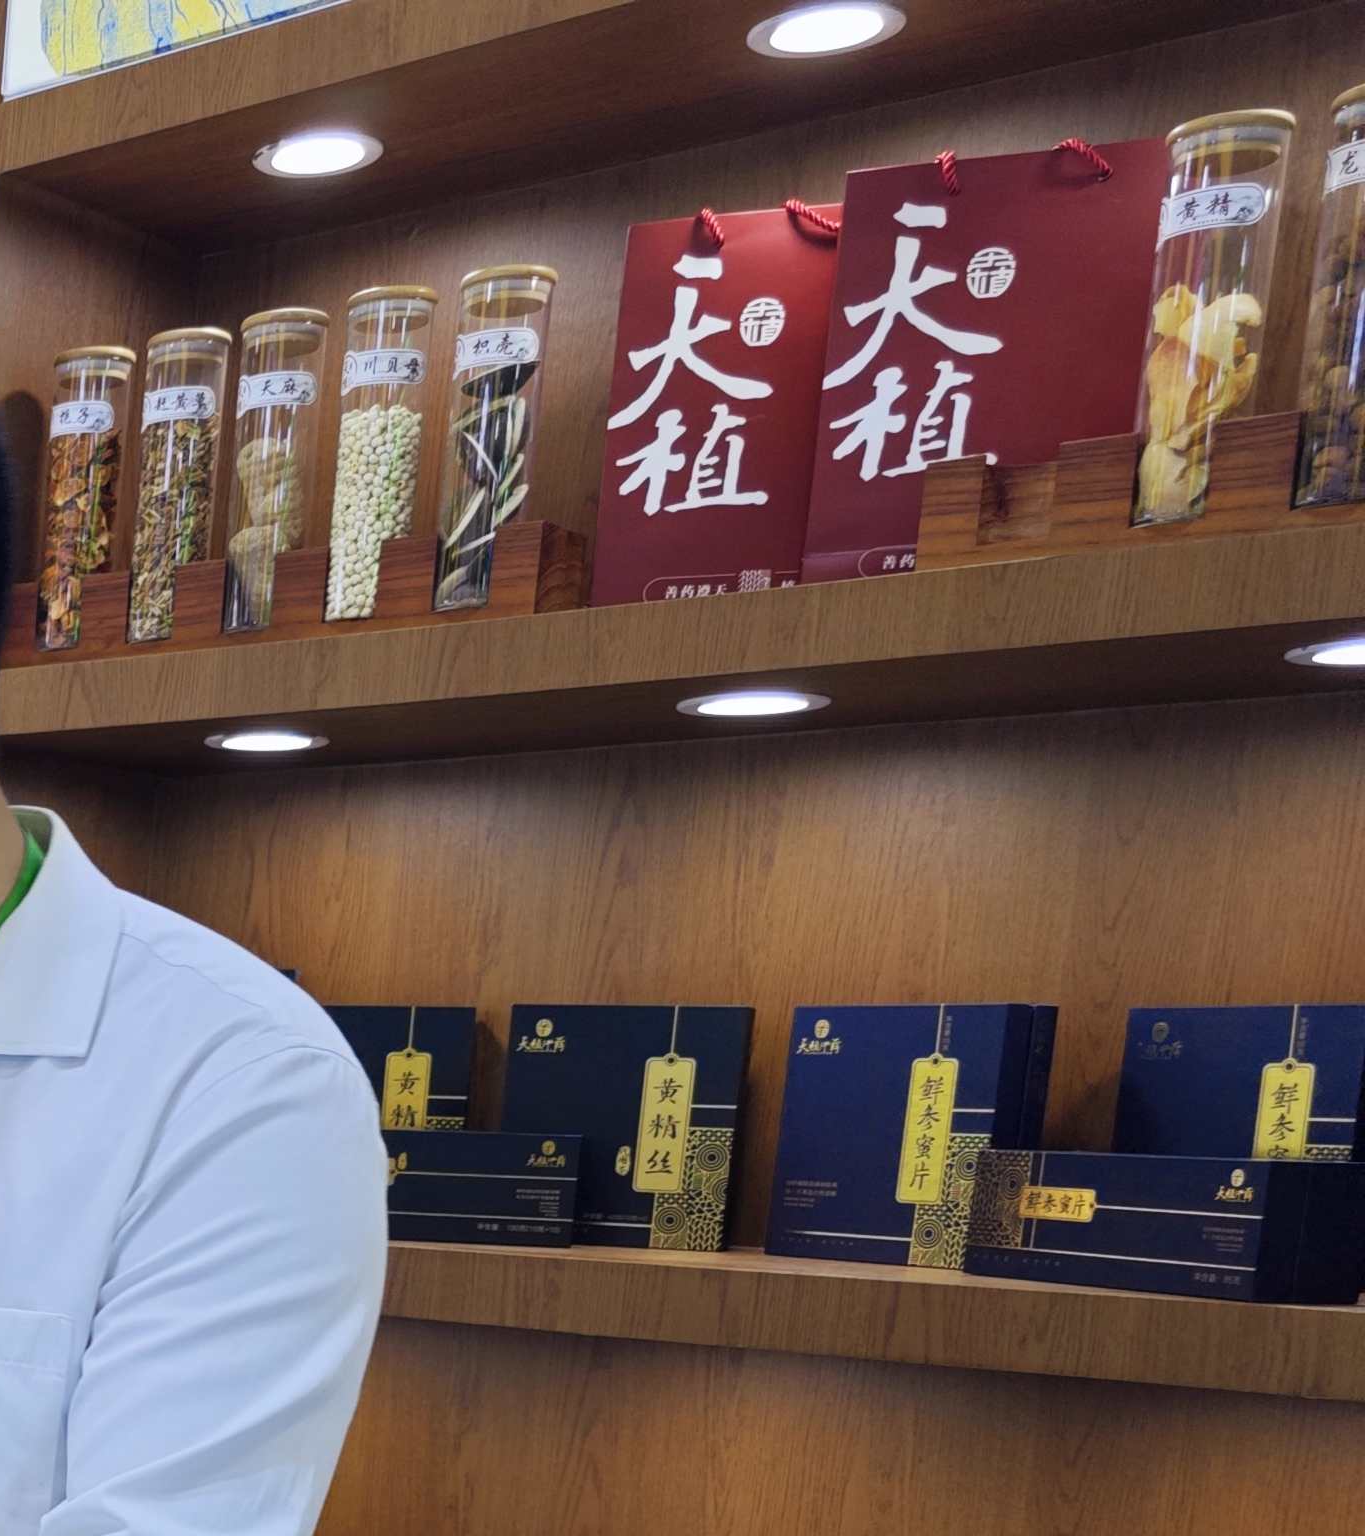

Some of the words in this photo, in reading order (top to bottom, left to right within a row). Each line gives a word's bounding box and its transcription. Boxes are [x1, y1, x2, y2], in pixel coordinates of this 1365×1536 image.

[1177, 192, 1233, 225] 黄精
[608, 256, 773, 517] 天植
[644, 1077, 684, 1175] 黄精丝
